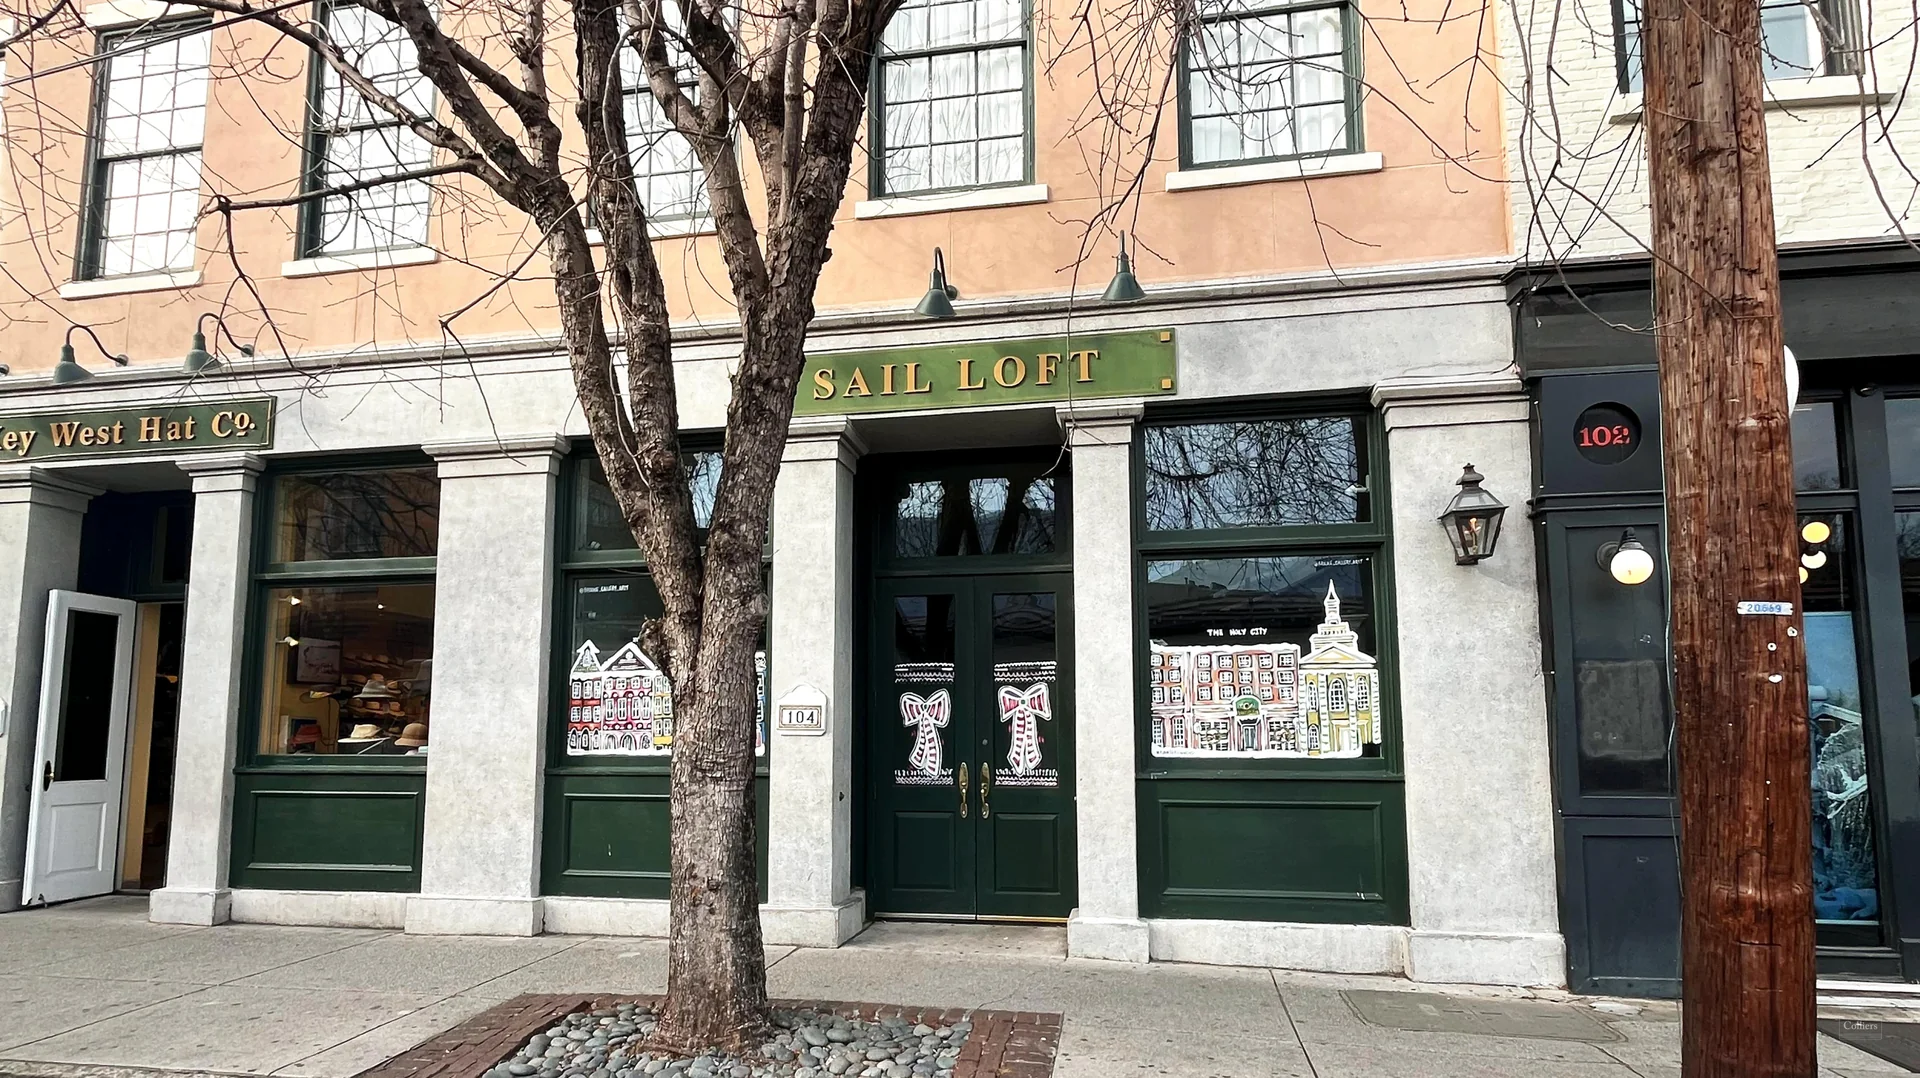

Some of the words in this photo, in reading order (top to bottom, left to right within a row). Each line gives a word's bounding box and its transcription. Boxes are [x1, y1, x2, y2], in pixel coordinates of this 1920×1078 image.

[813, 361, 932, 400] SAIL
[957, 349, 1100, 390] LOFT
[0, 425, 36, 456] ey
[50, 420, 124, 448] West
[138, 415, 196, 443] Hat
[211, 410, 256, 438] Co.
[1580, 425, 1631, 447] 102
[1206, 628, 1224, 637] THE
[1250, 627, 1268, 636] CITY
[788, 710, 815, 724] 104
